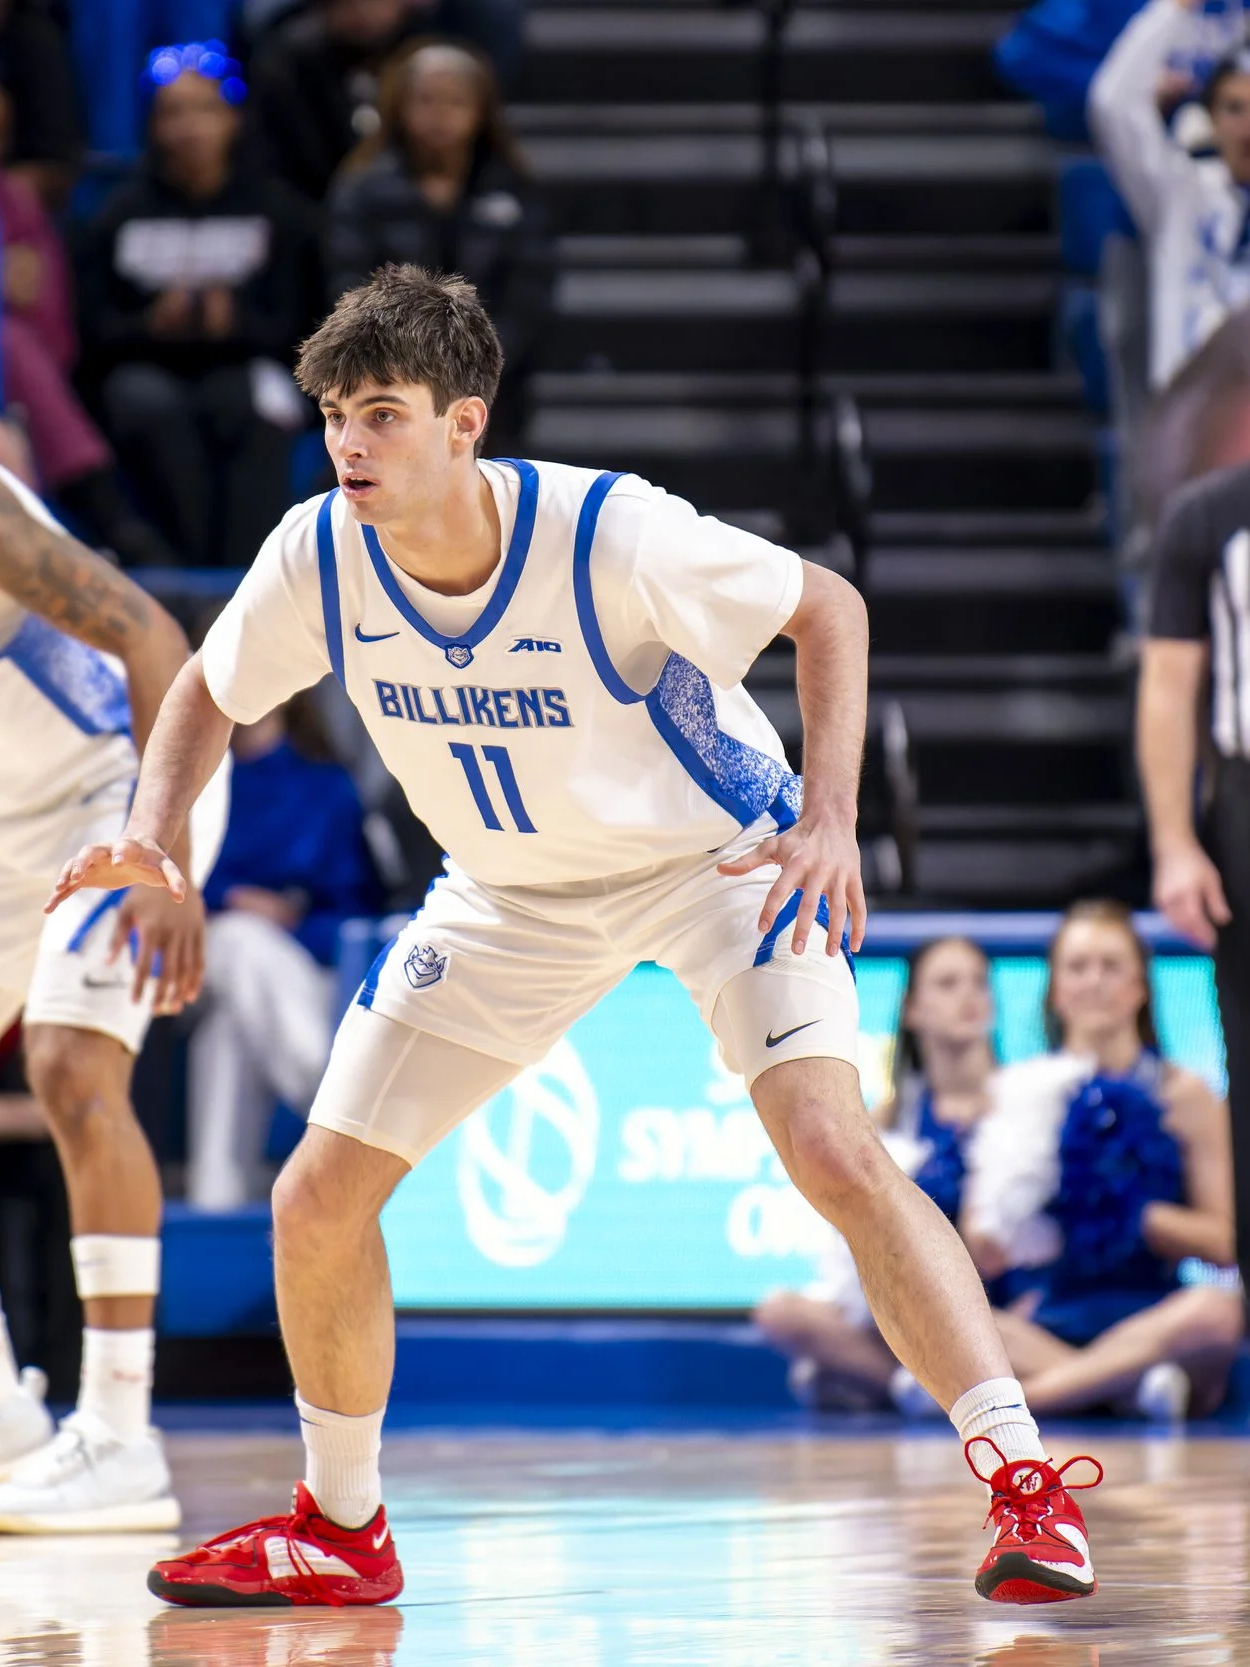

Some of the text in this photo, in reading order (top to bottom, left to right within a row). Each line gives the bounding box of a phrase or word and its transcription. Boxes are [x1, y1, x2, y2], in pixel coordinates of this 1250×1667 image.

[507, 638, 562, 653] A10
[373, 678, 576, 729] BILLIKENS
[447, 741, 539, 834] 11
